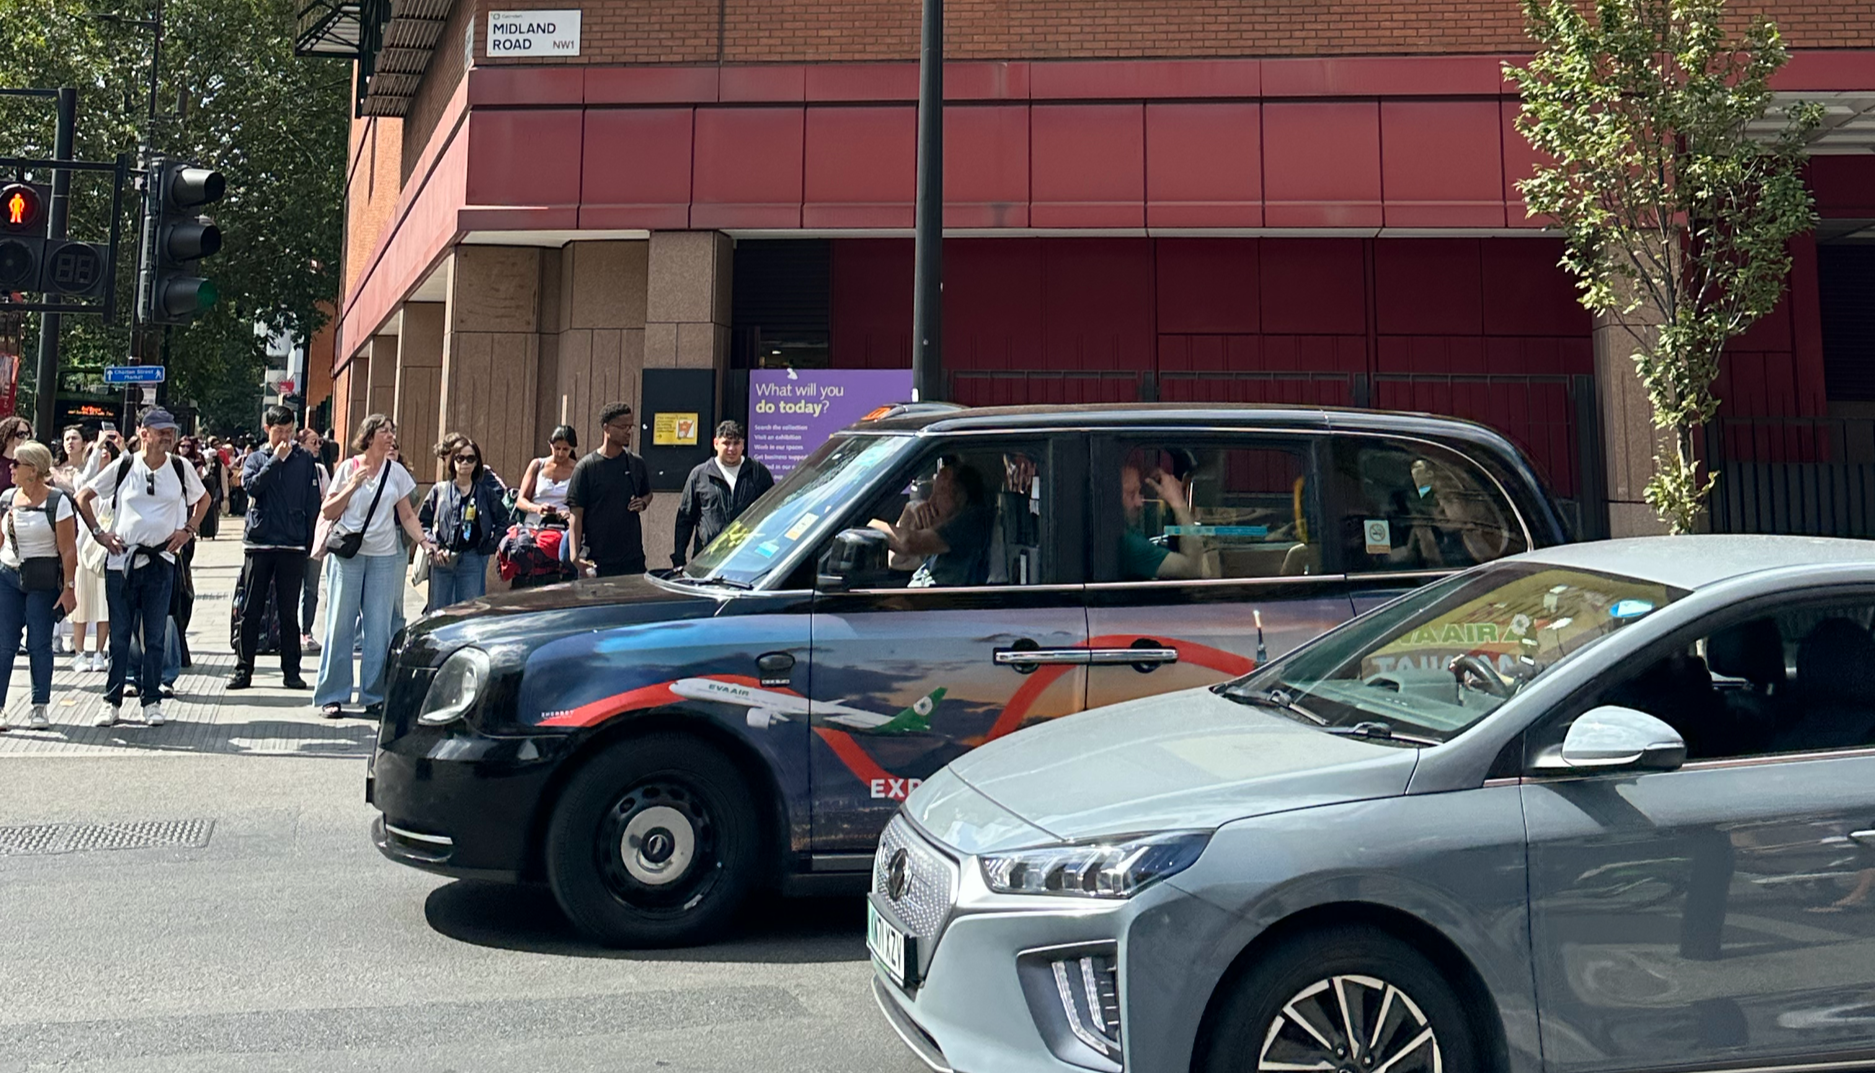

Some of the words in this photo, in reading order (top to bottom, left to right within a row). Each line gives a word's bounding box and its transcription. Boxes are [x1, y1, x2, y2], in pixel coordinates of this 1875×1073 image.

[493, 22, 556, 35] MIDLAND
[492, 38, 532, 51] ROAD
[552, 40, 575, 50] NW1
[755, 383, 792, 396] What
[795, 383, 817, 396] will
[820, 385, 844, 400] you
[755, 400, 775, 413] do
[779, 400, 830, 417] today?
